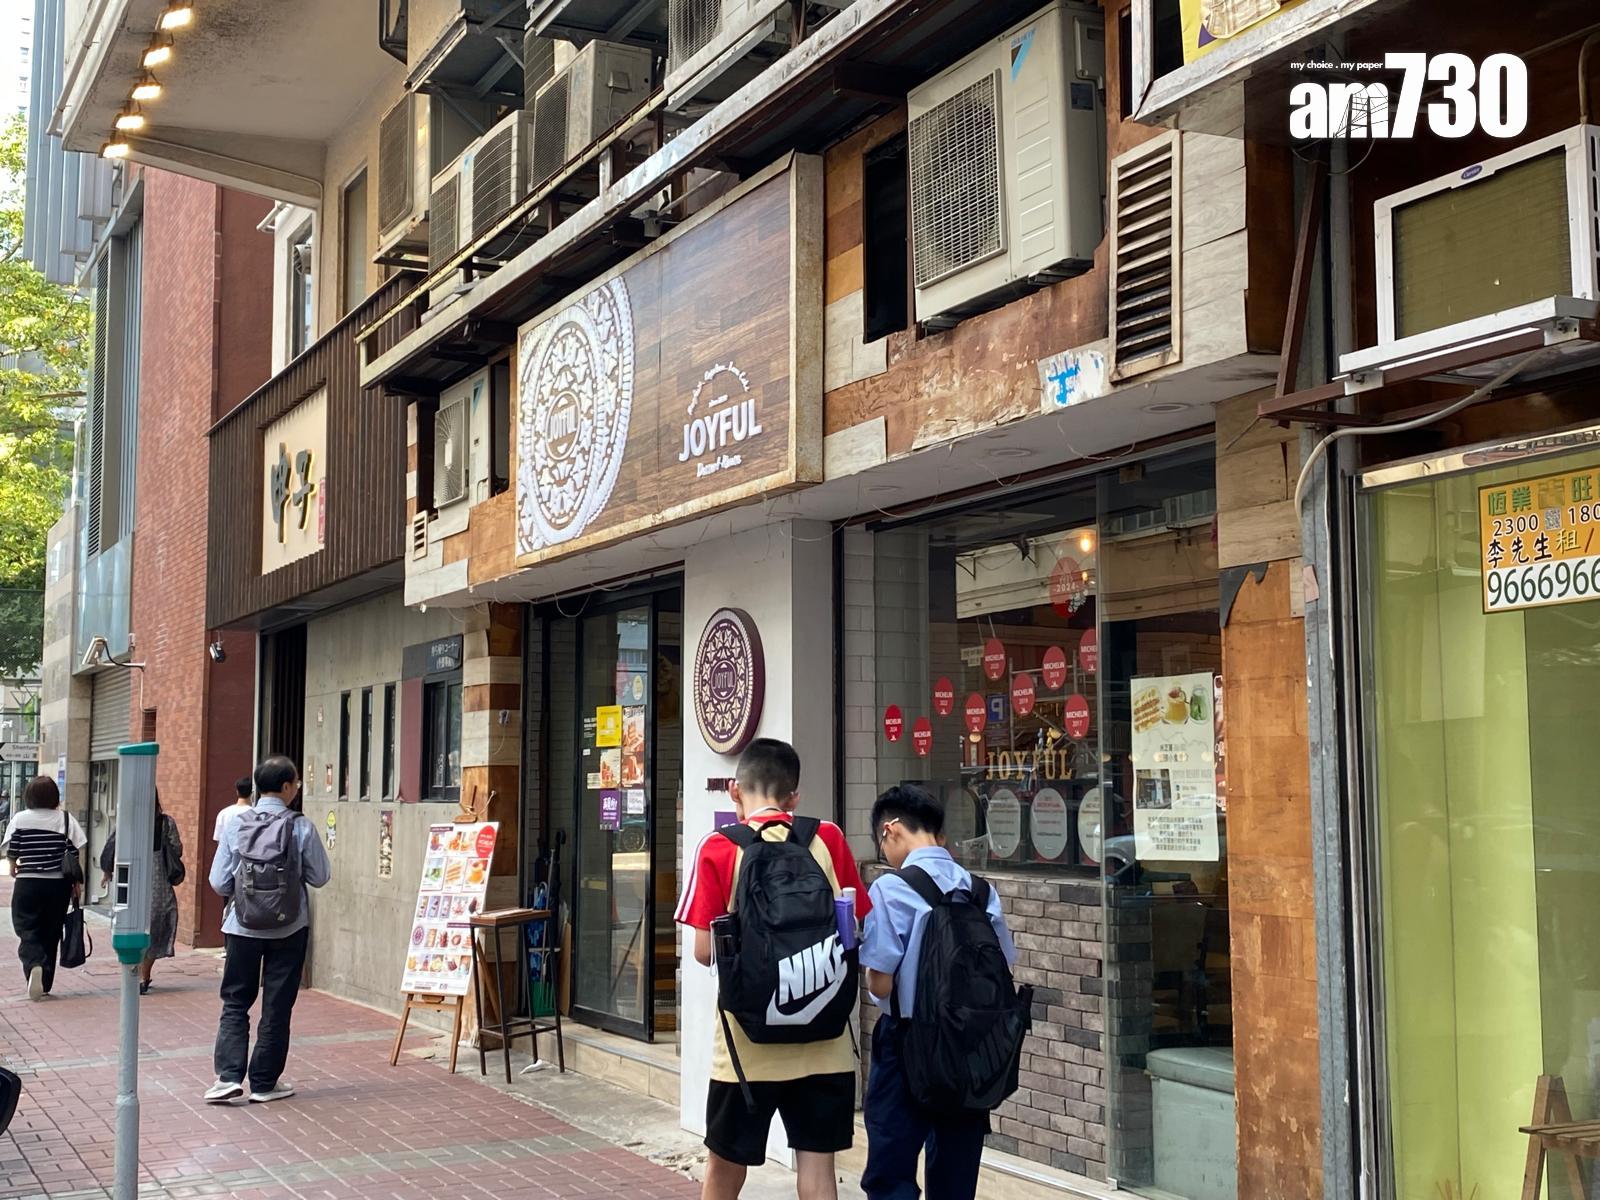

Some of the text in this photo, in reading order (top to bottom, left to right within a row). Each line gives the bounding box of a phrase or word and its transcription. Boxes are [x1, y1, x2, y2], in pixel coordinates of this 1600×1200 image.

[547, 404, 577, 443] JOYFUL
[678, 398, 762, 462] JOYFUL
[1571, 474, 1600, 503] 旺
[1493, 514, 1539, 538] 2300
[1487, 531, 1553, 569] 李先生
[713, 671, 735, 689] JOYFUL
[986, 749, 1073, 781] JOYFUL
[777, 930, 848, 1006] NIKE
